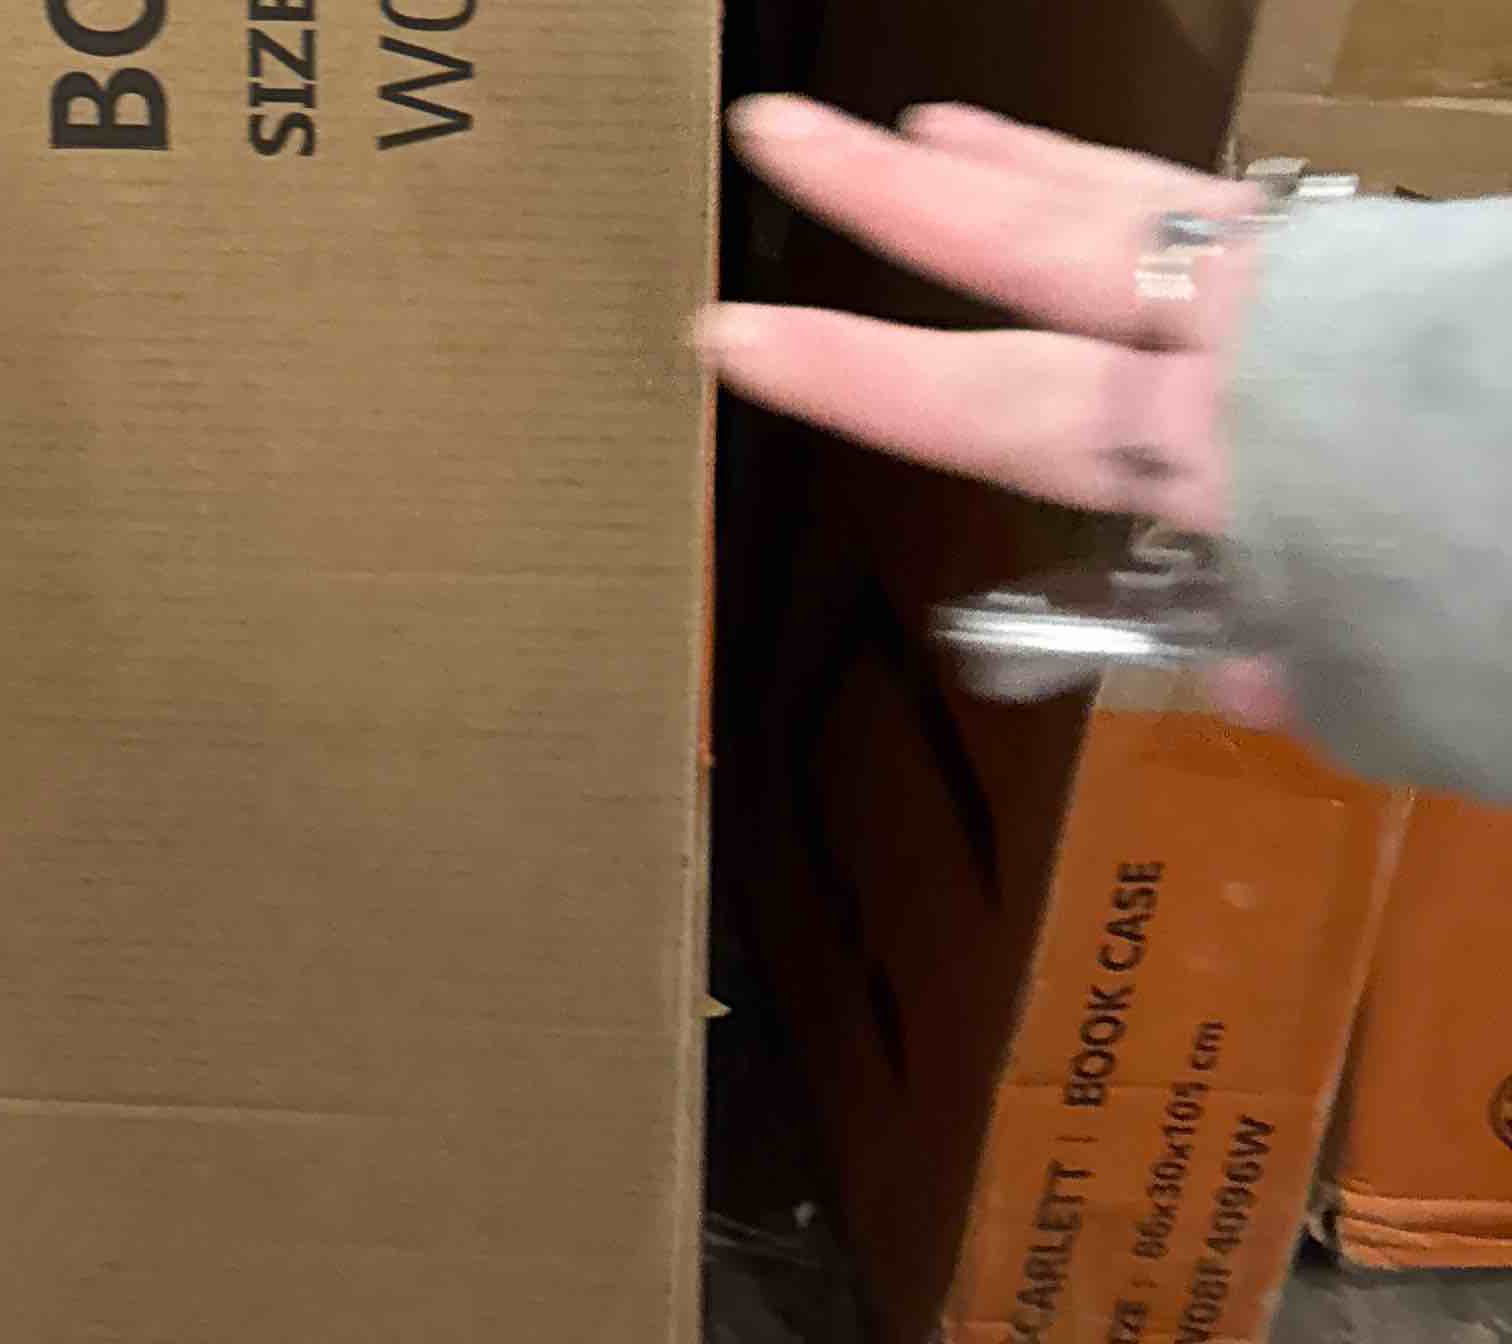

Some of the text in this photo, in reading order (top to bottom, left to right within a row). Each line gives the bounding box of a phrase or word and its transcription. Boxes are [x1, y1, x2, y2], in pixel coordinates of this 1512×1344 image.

[1096, 861, 1167, 973] CASE
[1061, 983, 1137, 1108] BOOK
[1189, 1020, 1226, 1072] cm
